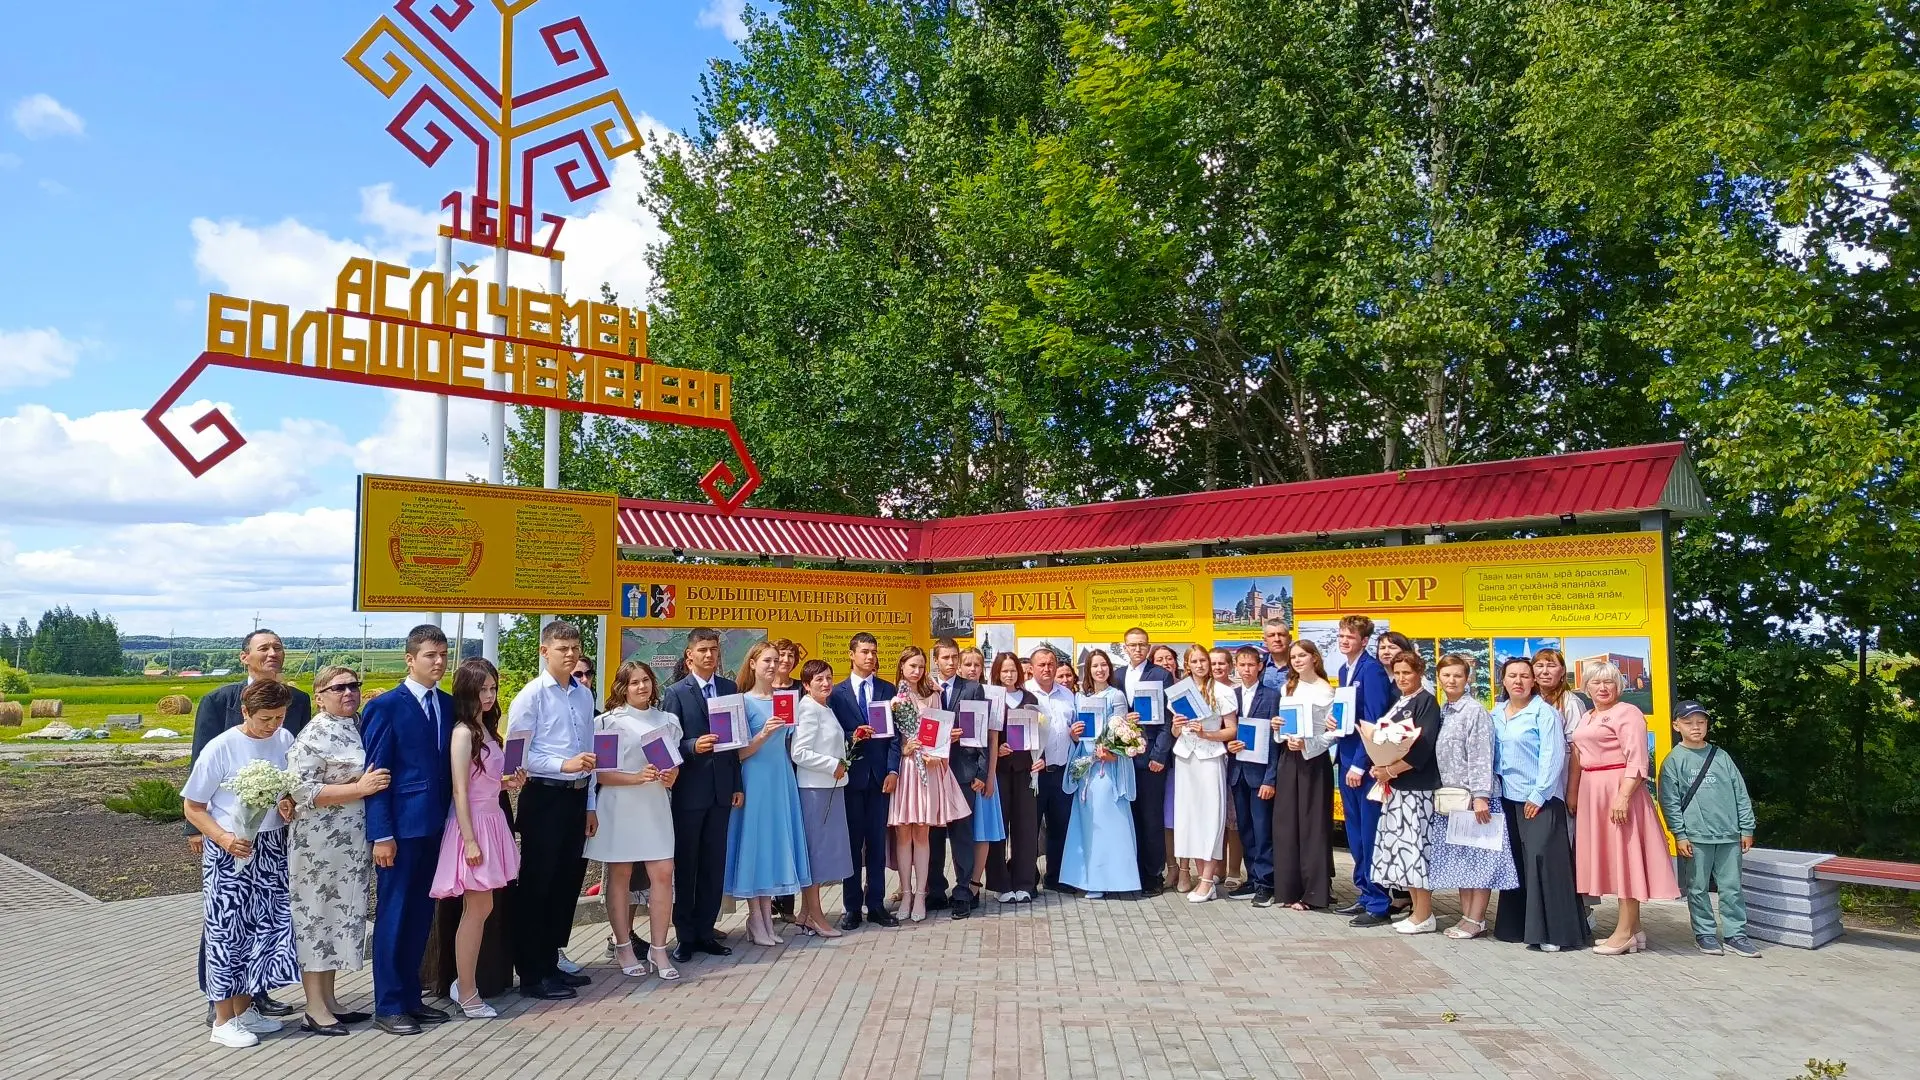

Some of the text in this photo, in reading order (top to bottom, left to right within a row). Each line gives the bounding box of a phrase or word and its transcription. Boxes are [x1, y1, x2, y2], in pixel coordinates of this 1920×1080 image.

[440, 191, 566, 258] 1607
[487, 284, 647, 358] ЧЕМЕН
[206, 293, 731, 420] БОЛЬШОЕ ЧЕМЕНЕВО
[686, 586, 888, 606] БОЛЬШЕЧЕМЕНЕВСКИЙ
[1367, 576, 1438, 602] ПУР
[685, 606, 913, 625] ТЕРРИТОРИАЛЬНЫЙ ОТДЕЛ
[1551, 612, 1632, 622] Альбина ЮРАТУ
